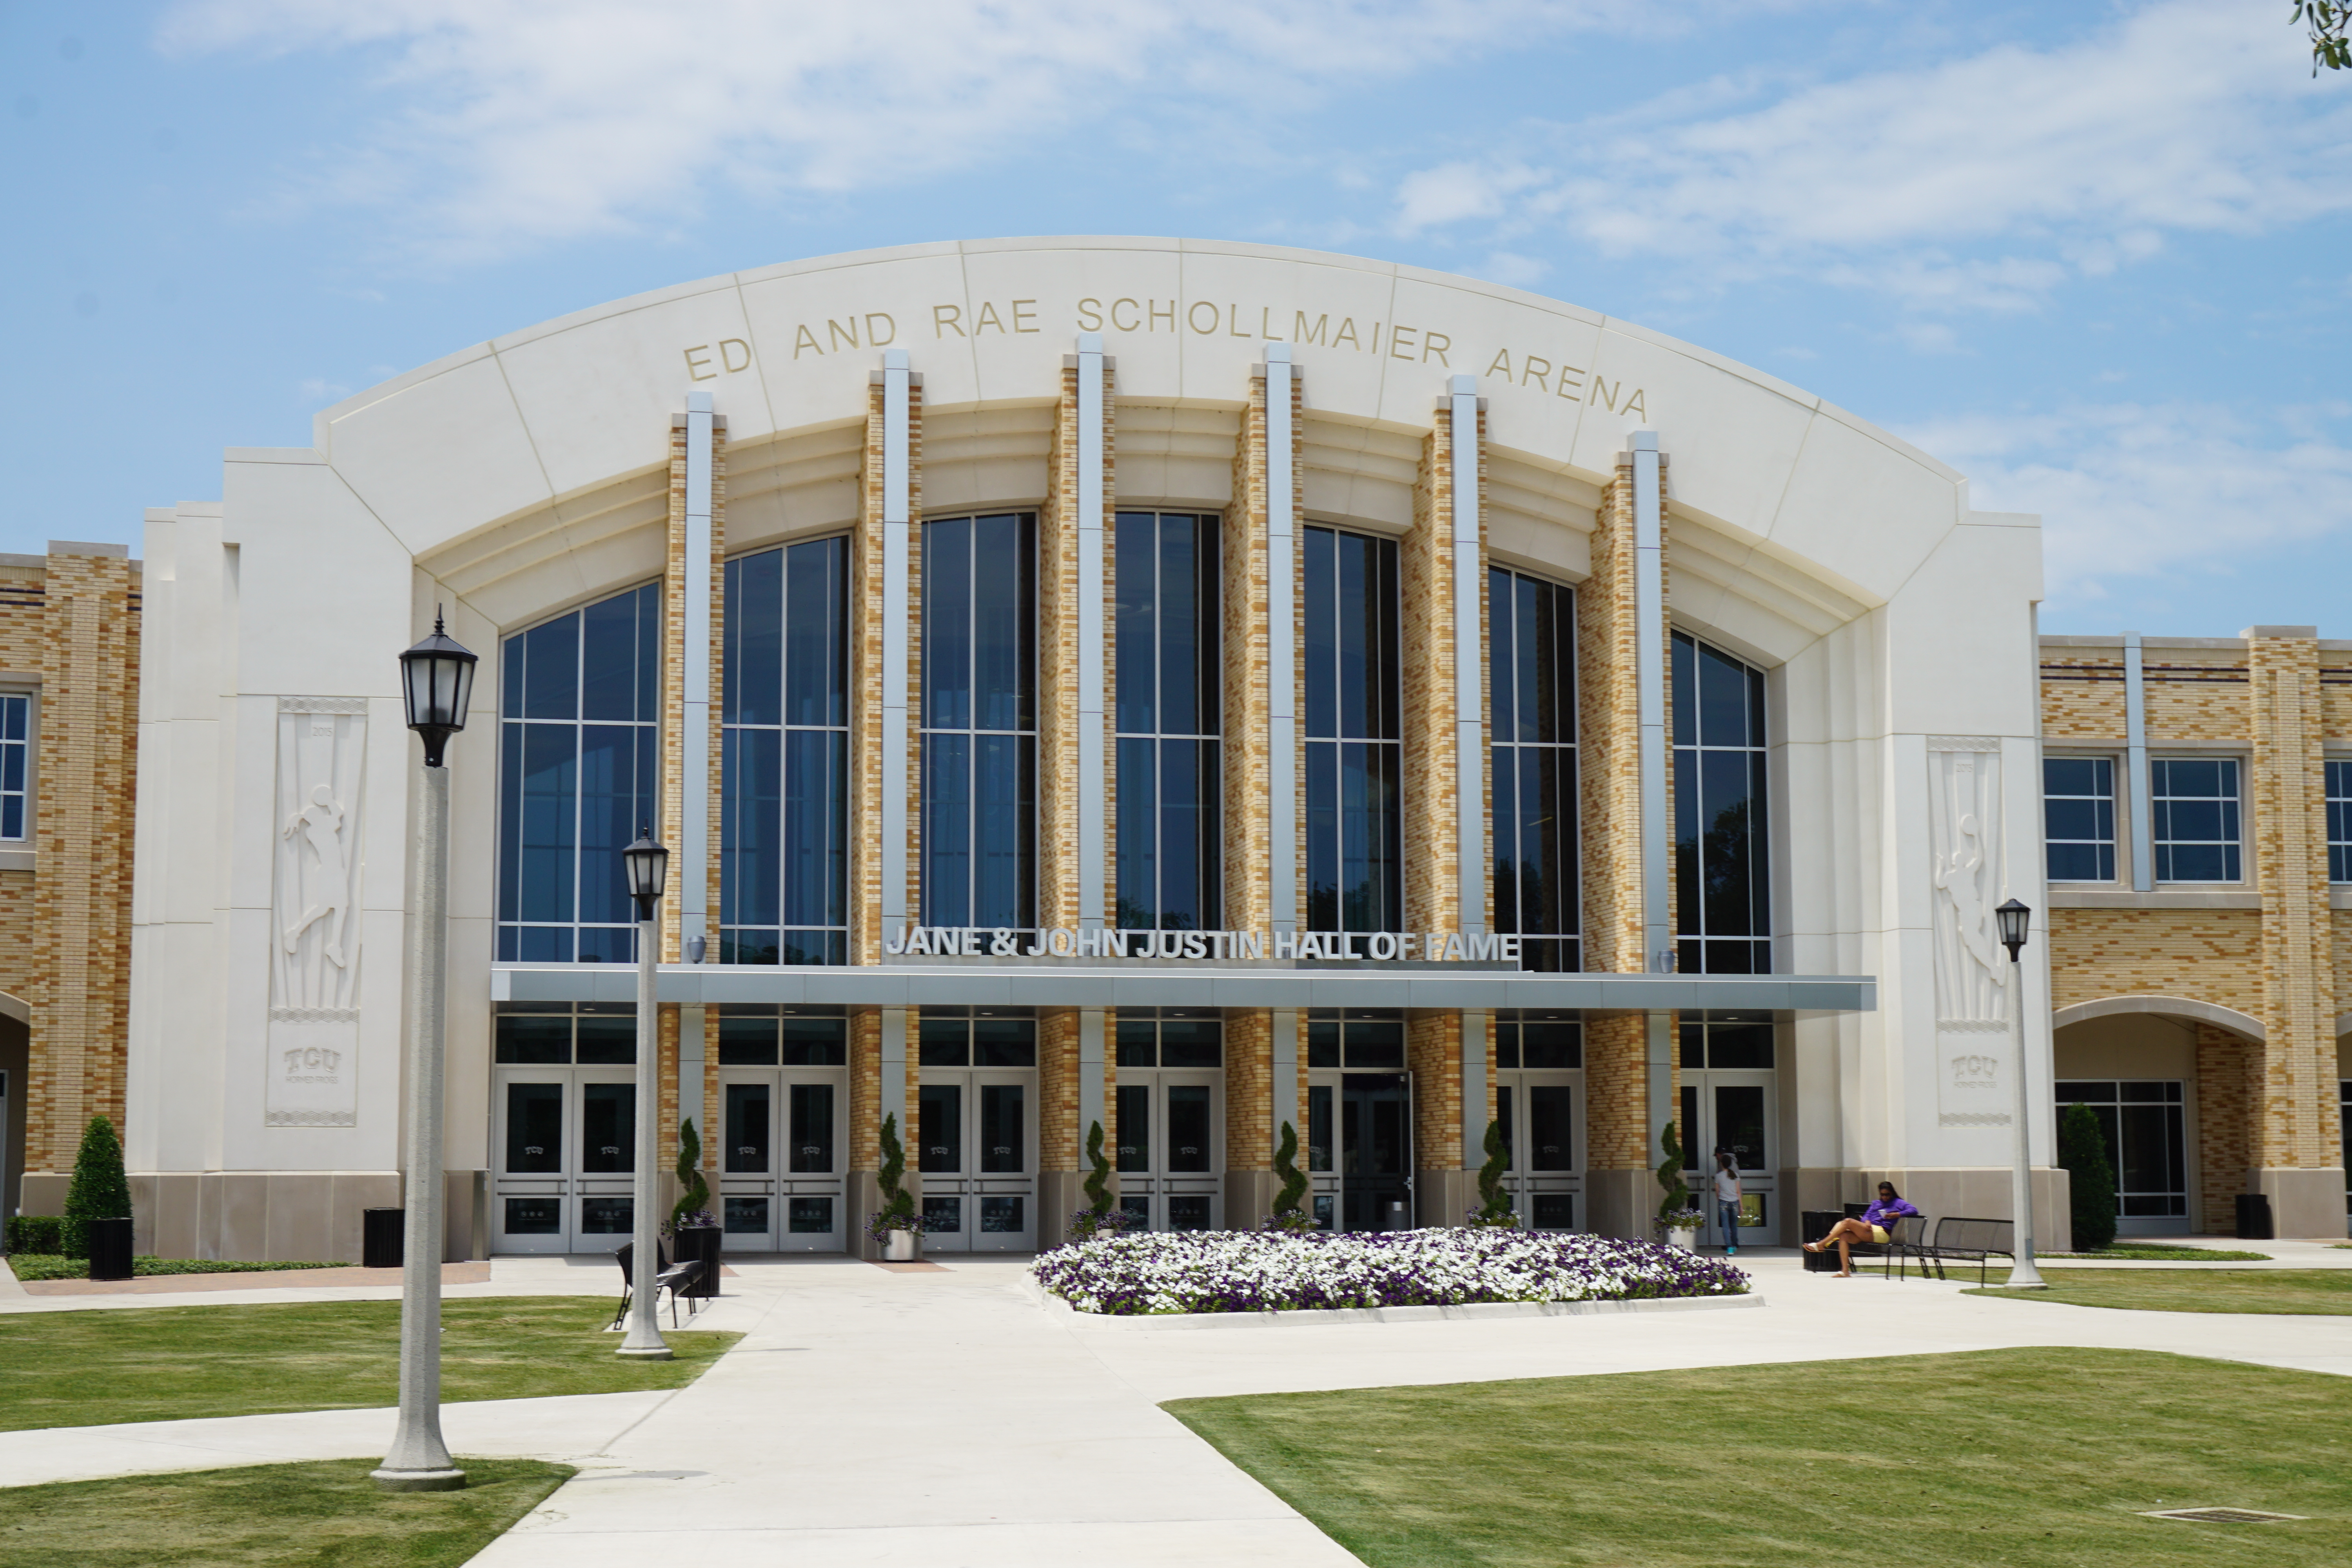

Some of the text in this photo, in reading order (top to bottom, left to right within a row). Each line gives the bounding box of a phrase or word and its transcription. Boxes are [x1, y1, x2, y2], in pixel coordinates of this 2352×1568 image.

[683, 298, 1648, 424] ED AND RAE SCHOLLMAIER ARENA
[312, 727, 333, 737] 2015
[885, 926, 1520, 962] JANE & JOHN JUSTIN HALL OF FAME
[283, 1047, 341, 1074] TCU
[1951, 1055, 1999, 1080] TCU
[525, 1146, 544, 1155] TCU
[601, 1146, 619, 1155] TCU
[738, 1146, 756, 1155] TCU
[802, 1146, 820, 1155] TCU
[930, 1146, 948, 1155] TCU
[993, 1146, 1011, 1155] TCU
[1119, 1146, 1137, 1154] TCU
[1180, 1146, 1198, 1154] TCU
[1543, 1145, 1559, 1153] TCU
